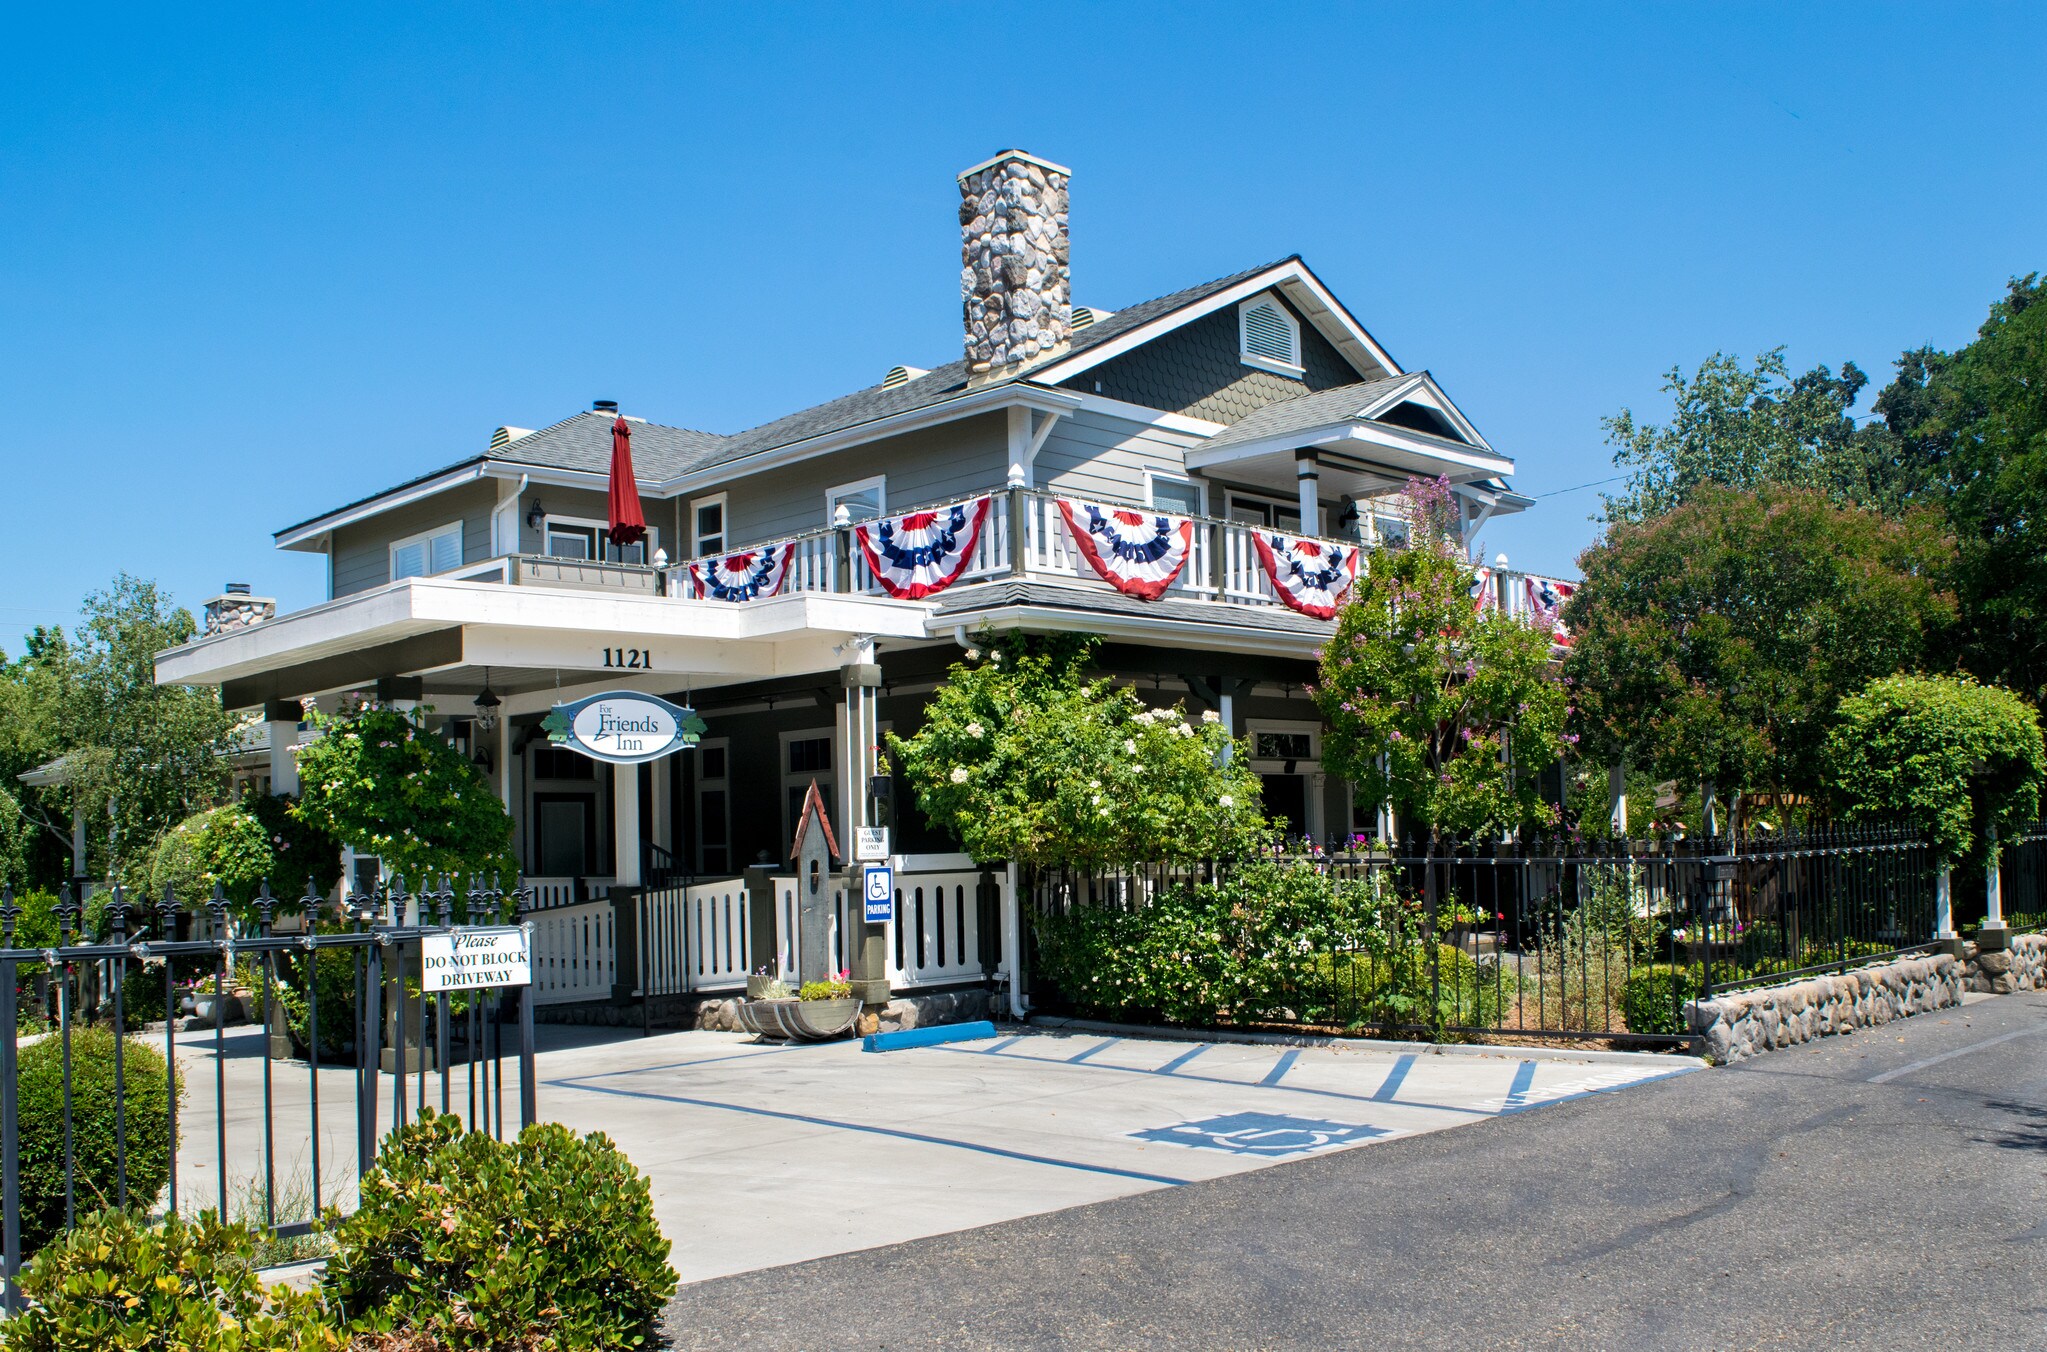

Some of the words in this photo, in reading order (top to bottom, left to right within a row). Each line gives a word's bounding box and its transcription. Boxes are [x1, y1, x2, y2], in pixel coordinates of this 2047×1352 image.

[603, 647, 652, 669] 1121
[599, 704, 612, 714] For
[597, 714, 659, 736] Friends
[616, 734, 643, 751] Inn
[867, 904, 891, 915] PARKING
[454, 934, 498, 950] Please
[425, 956, 447, 969] DO
[450, 953, 479, 968] NOT
[481, 951, 527, 966] BLOCK
[441, 969, 513, 987] DRIVEWAY
